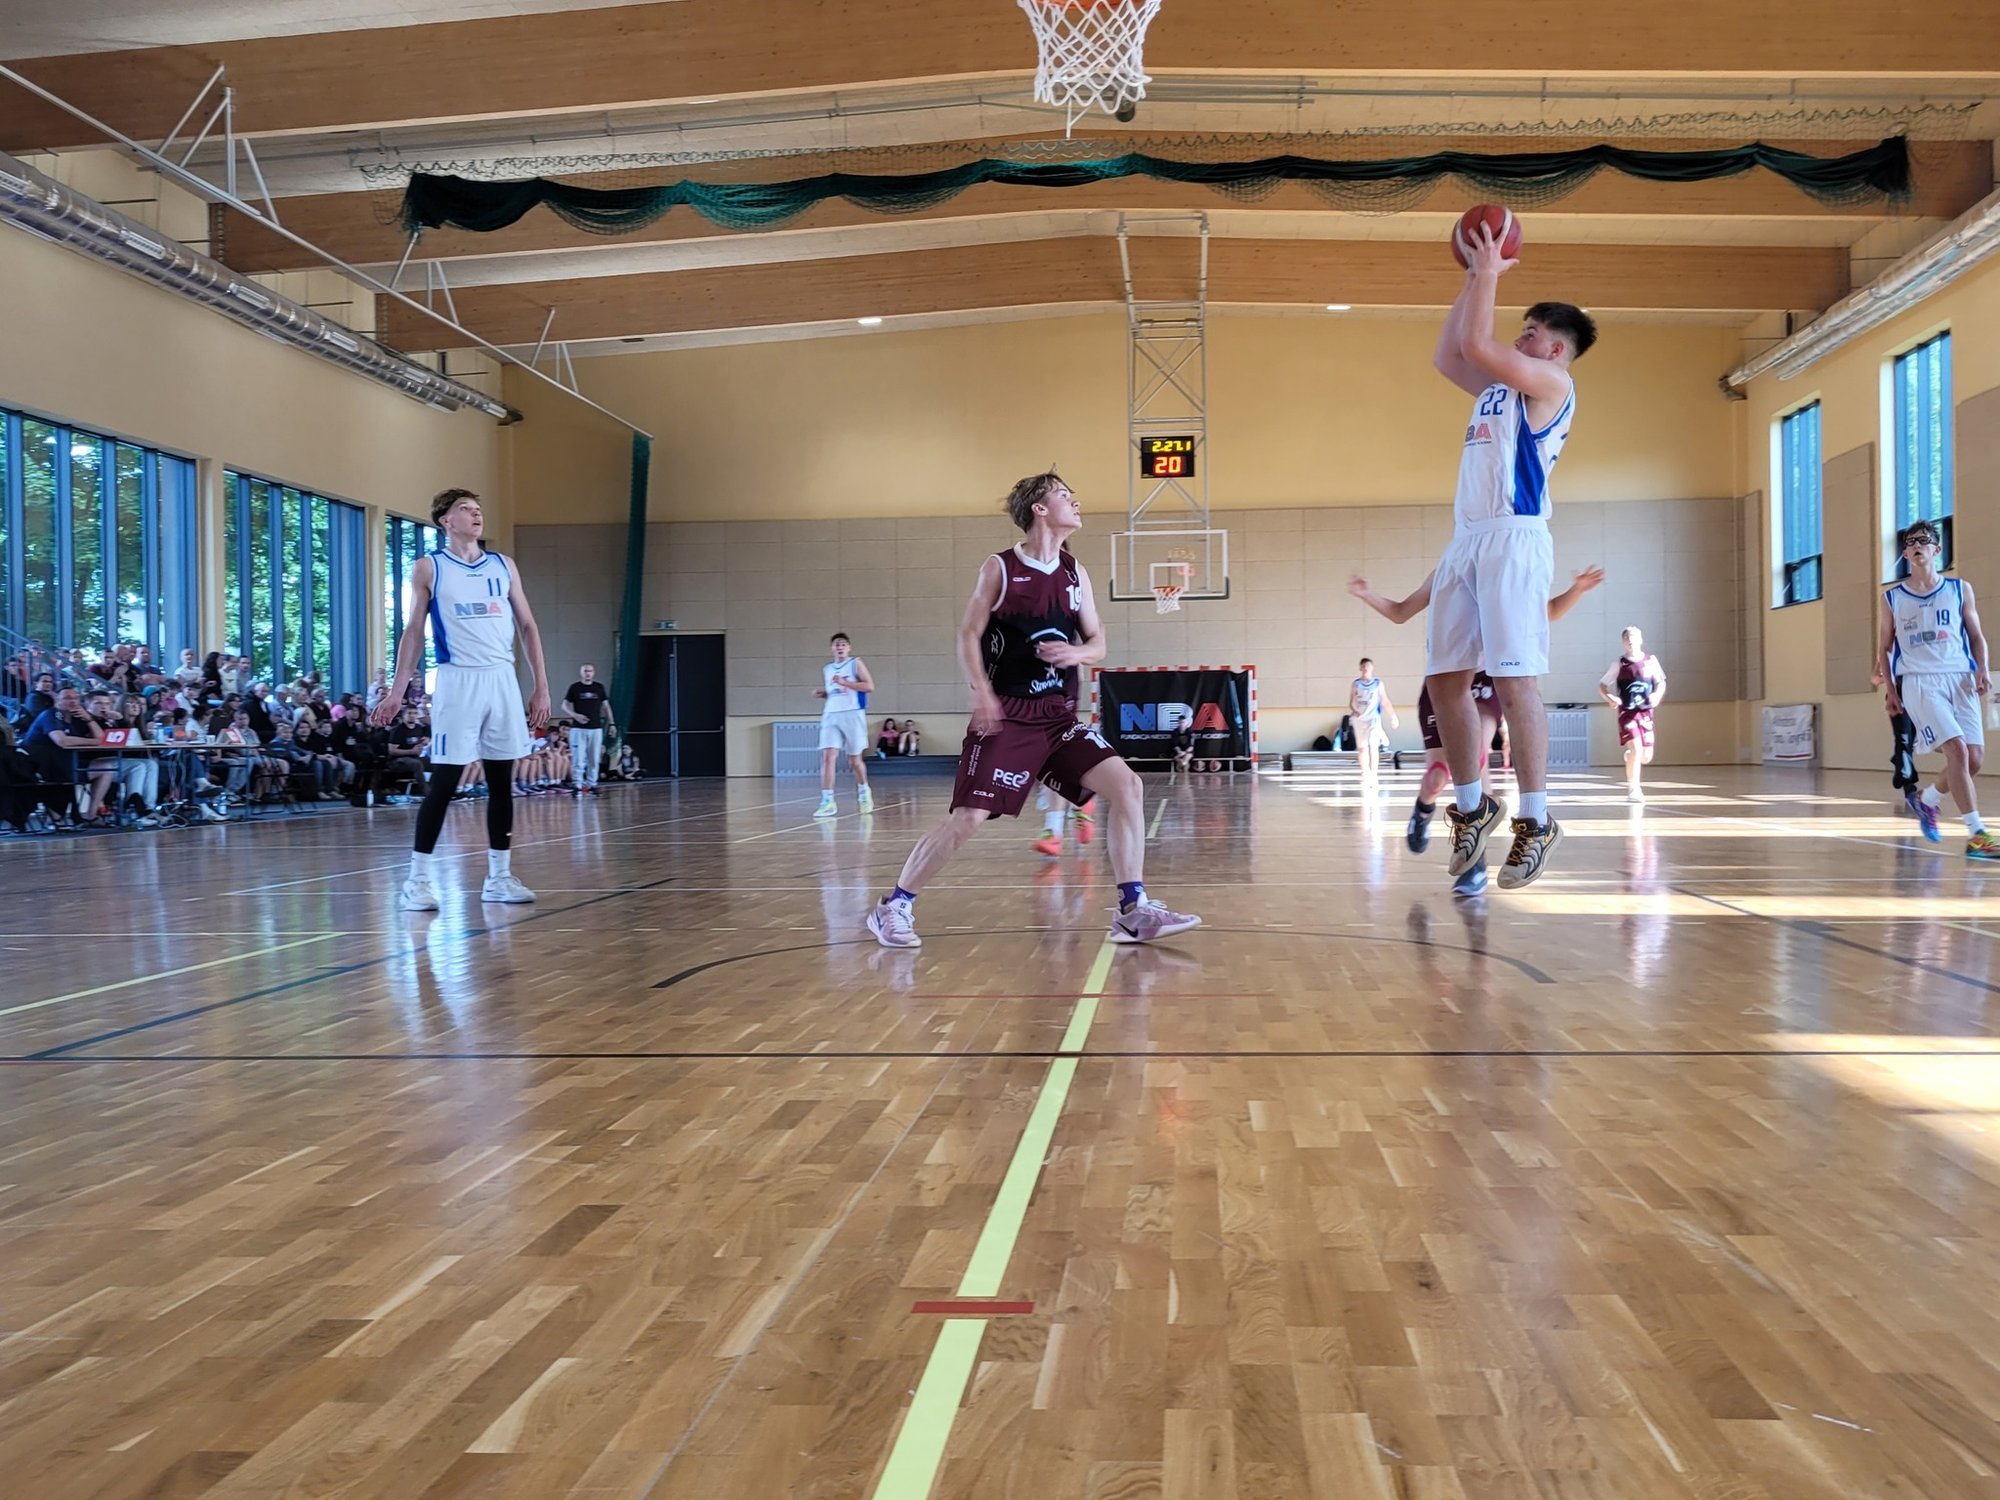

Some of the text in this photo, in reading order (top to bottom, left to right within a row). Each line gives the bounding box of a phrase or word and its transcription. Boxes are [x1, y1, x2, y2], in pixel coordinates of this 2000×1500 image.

[1480, 386, 1508, 416] 22
[1465, 423, 1492, 442] BA
[1155, 456, 1181, 473] 20
[487, 577, 501, 597] 11
[454, 602, 502, 616] NBA
[1936, 609, 1950, 626] 19
[1120, 702, 1230, 732] NBA
[434, 733, 447, 756] 11
[1921, 726, 1936, 746] 19
[992, 768, 1023, 788] PEC
